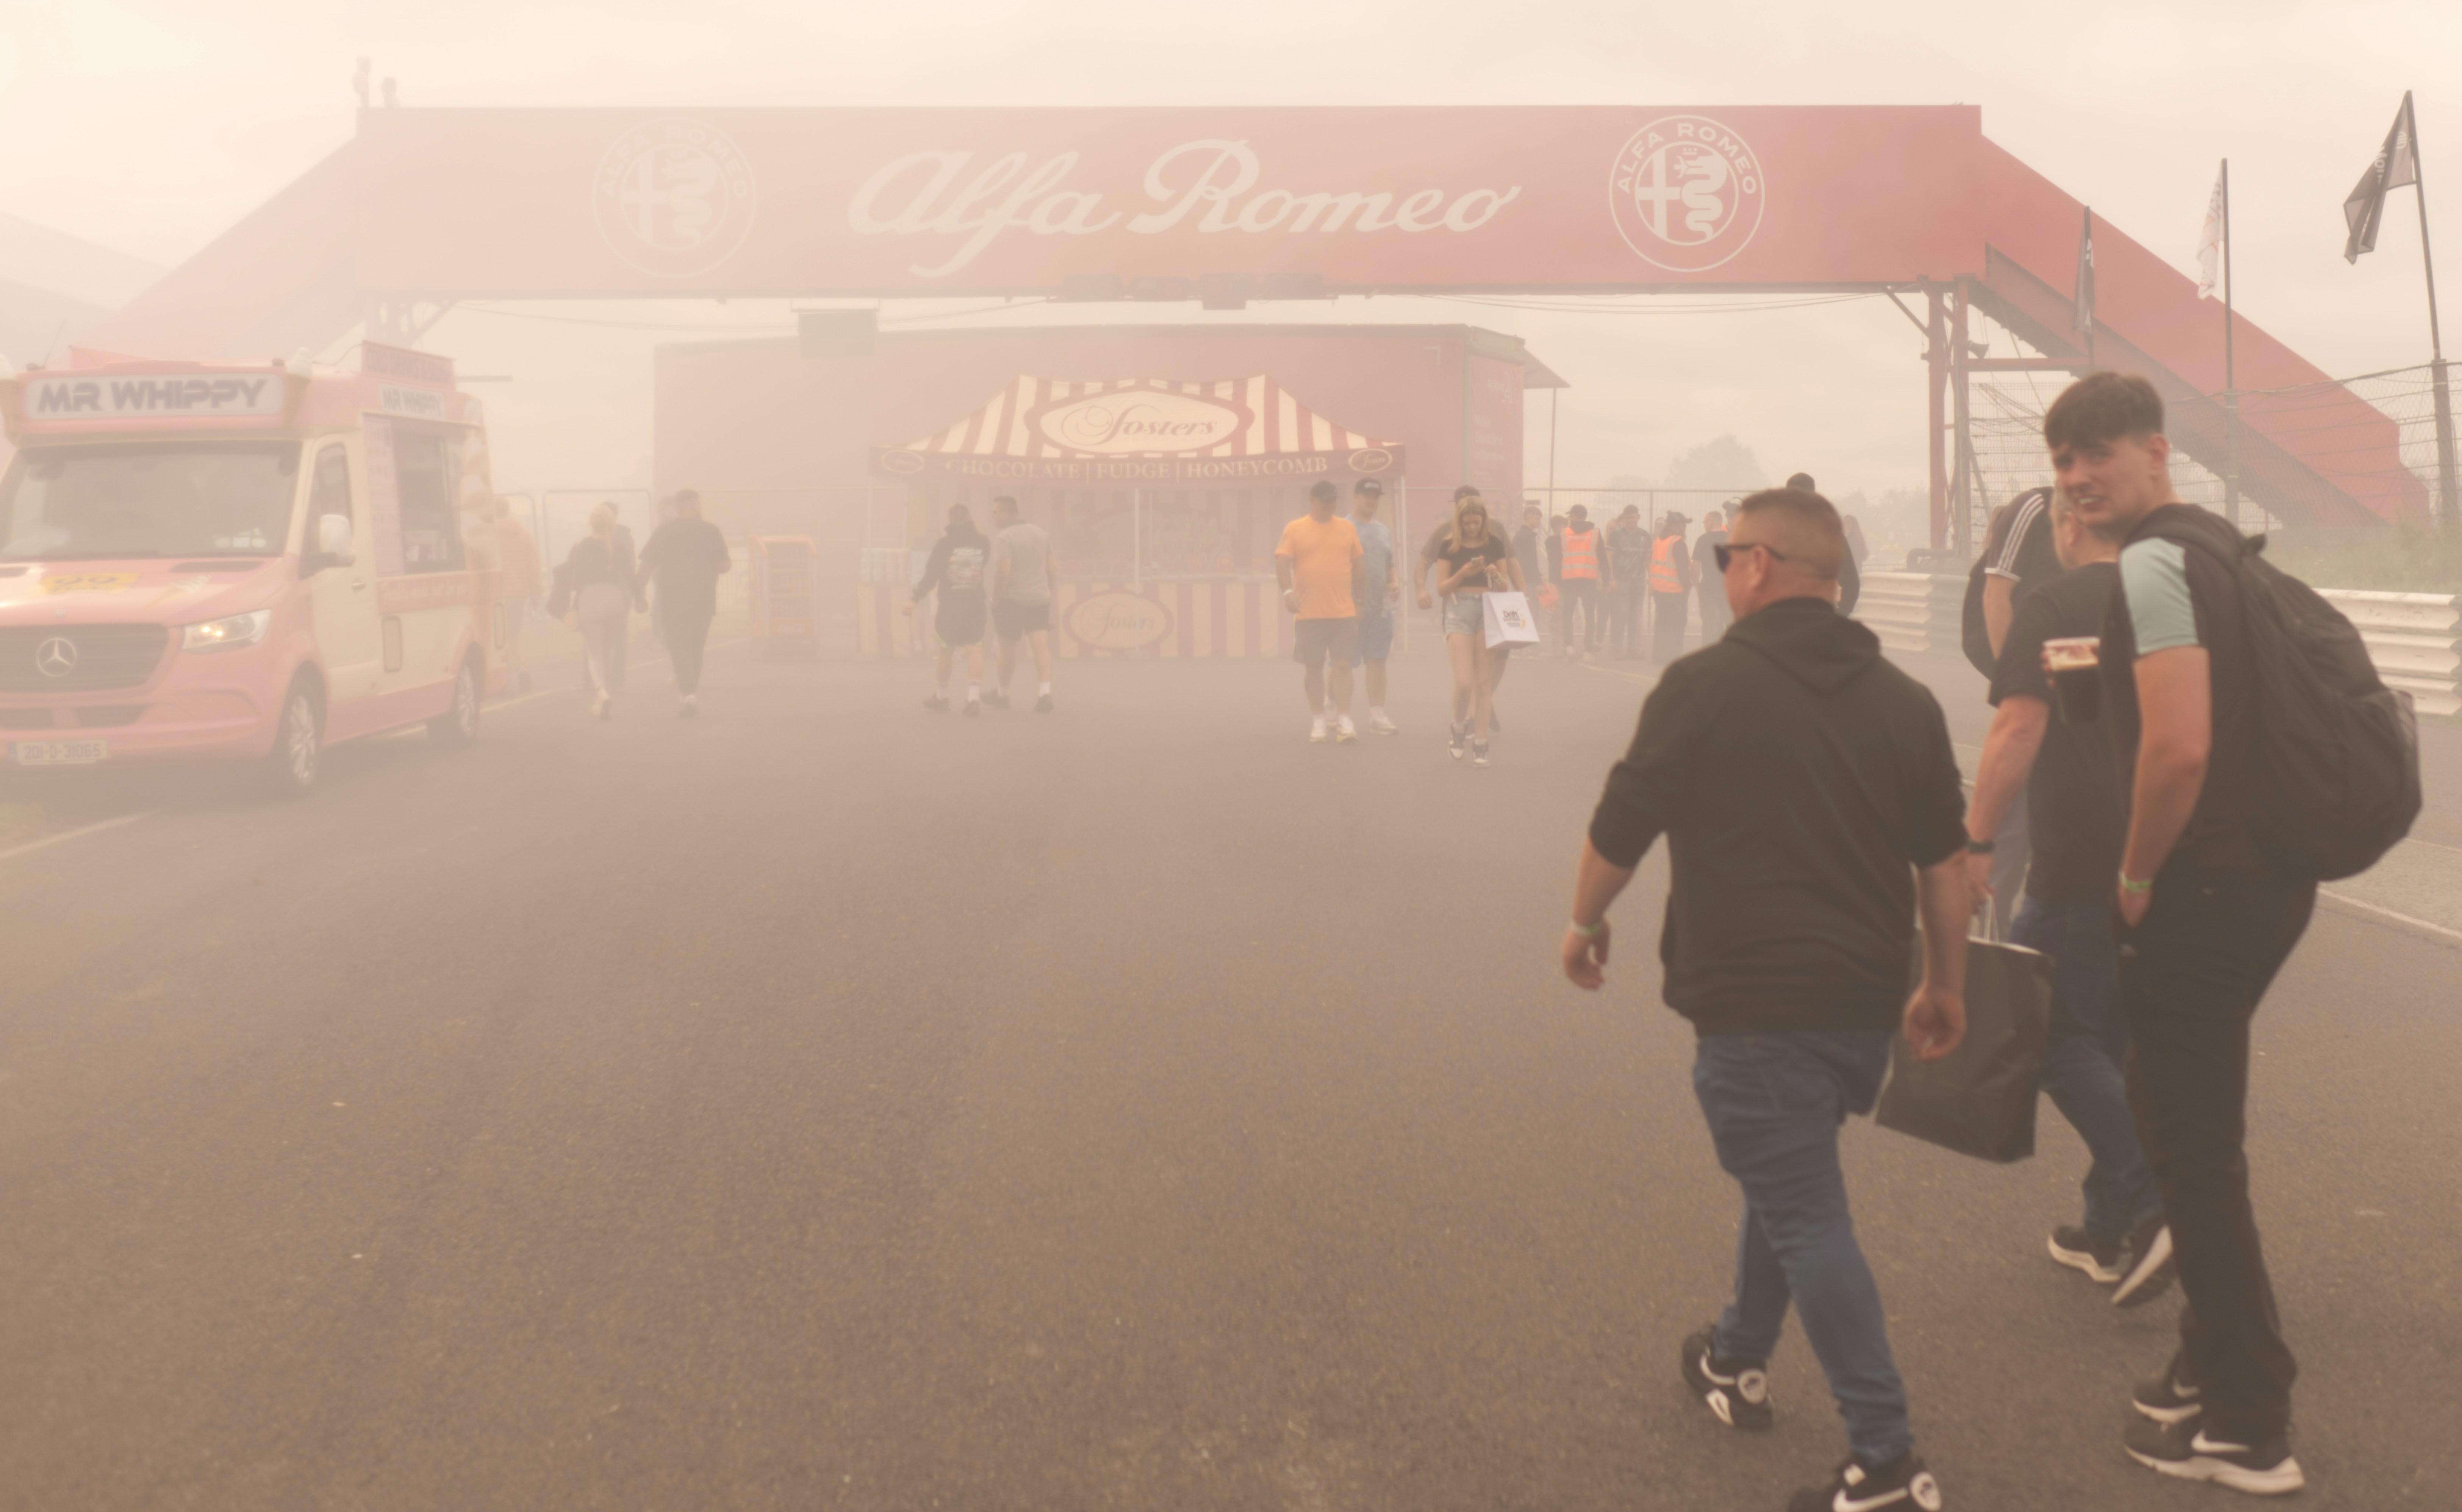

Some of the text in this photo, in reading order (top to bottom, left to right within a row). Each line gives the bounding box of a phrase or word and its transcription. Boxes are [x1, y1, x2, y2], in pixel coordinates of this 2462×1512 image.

[601, 124, 748, 198] ALFA ROMEO
[1617, 123, 1757, 194] ALFA ROMEO
[848, 139, 1522, 277] Alfa Romeo
[38, 379, 268, 413] MR WHIPPY
[1062, 404, 1217, 446] Fosters
[946, 457, 1327, 479] CHOCOLATE FUDGE HONEYCOMB
